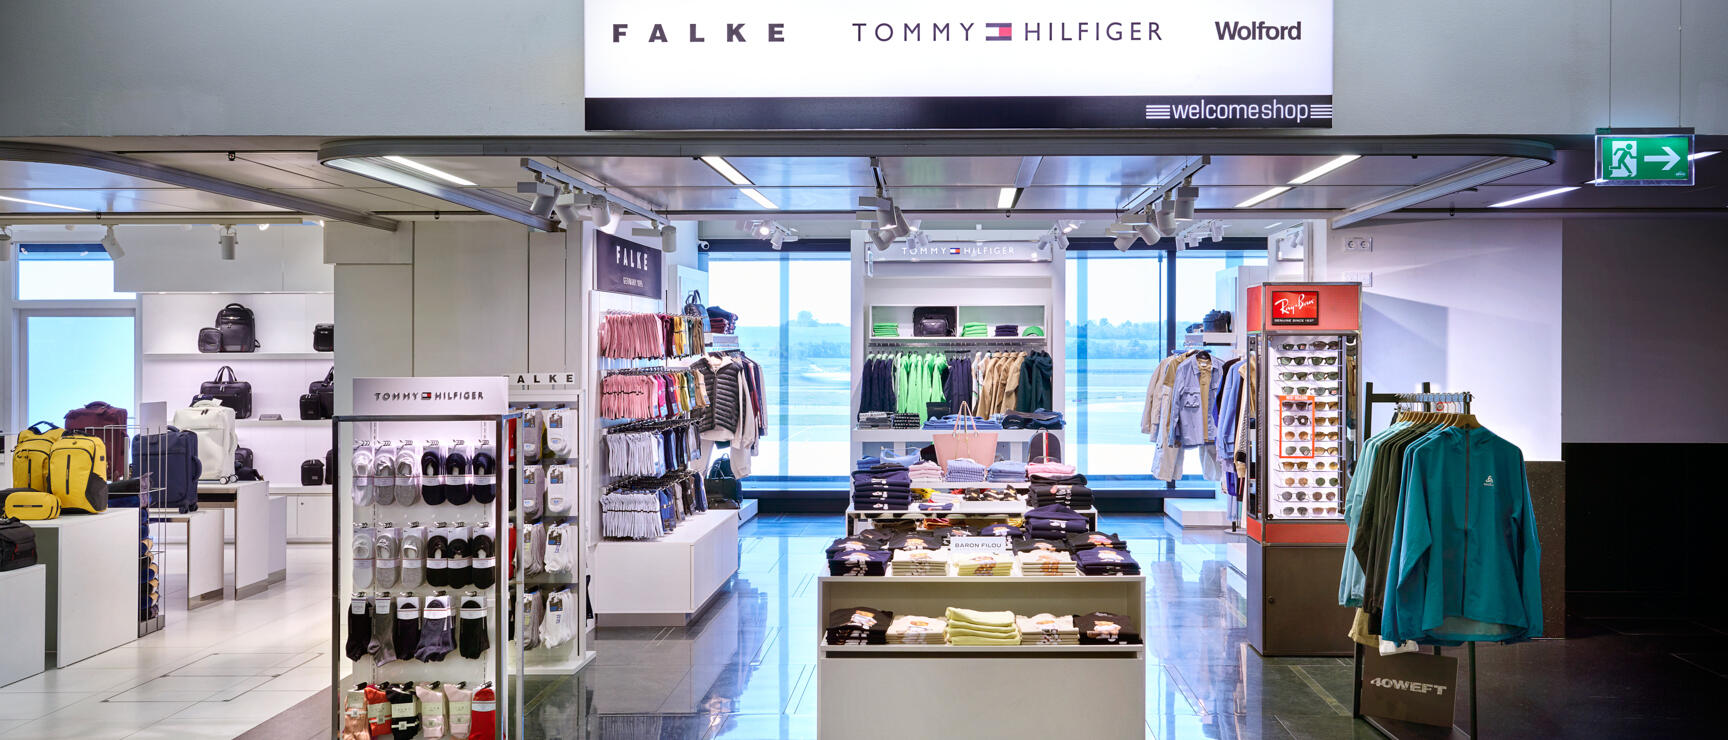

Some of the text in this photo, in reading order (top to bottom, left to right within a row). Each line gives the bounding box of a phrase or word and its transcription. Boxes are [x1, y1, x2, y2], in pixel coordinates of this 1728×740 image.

[613, 23, 785, 43] FALKE
[852, 22, 1163, 42] TOMMY HILFIGER
[1214, 21, 1302, 41] Wolford
[616, 245, 648, 270] FALKE
[902, 246, 1015, 255] TOMMY HILFIGER
[1274, 293, 1315, 315] Ray-Ban
[503, 374, 574, 385] ALKE
[374, 391, 484, 401] TOMMY HILFIGER
[1370, 677, 1447, 695] 40WEFT
